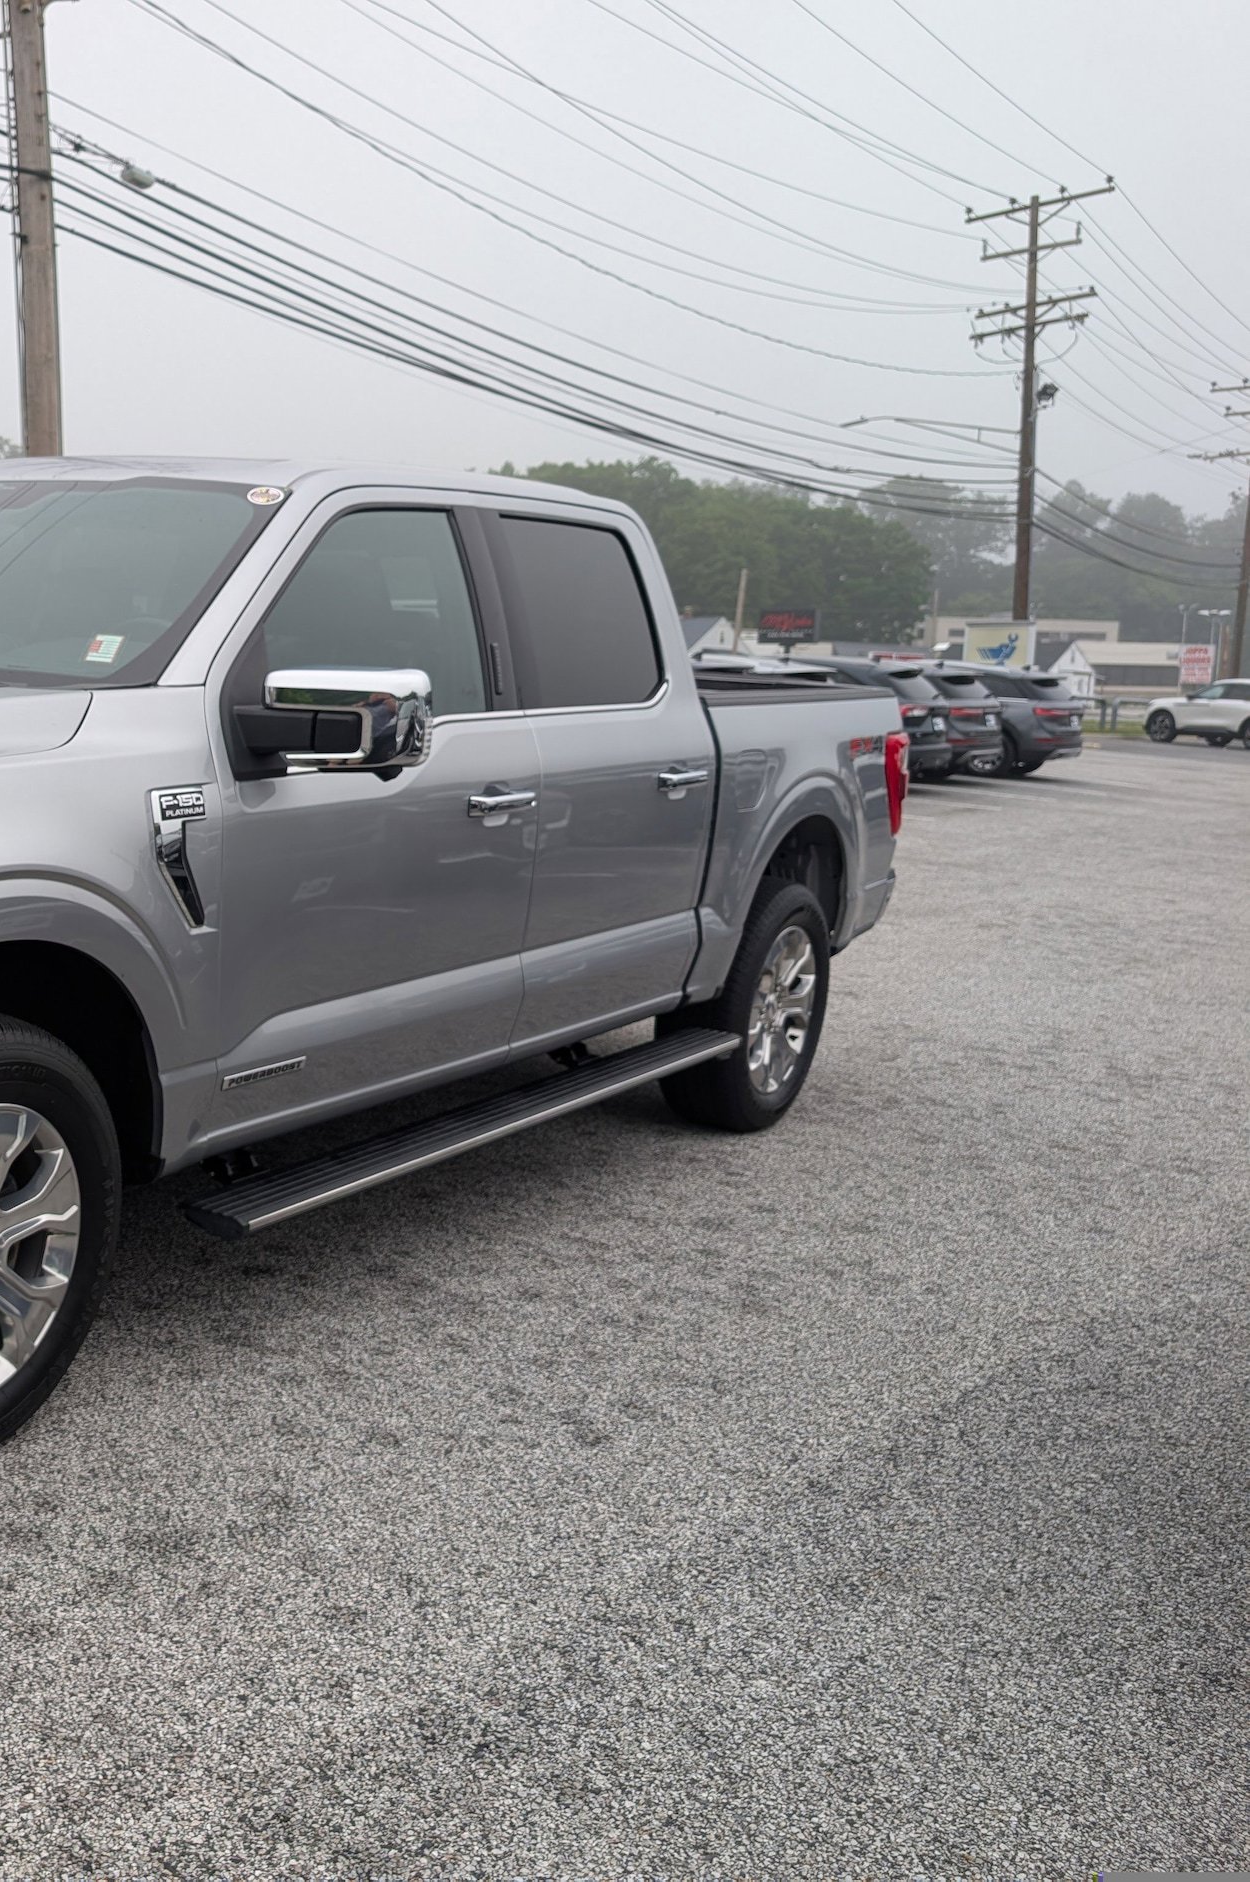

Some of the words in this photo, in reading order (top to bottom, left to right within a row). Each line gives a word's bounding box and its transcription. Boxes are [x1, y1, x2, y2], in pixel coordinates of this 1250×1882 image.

[849, 736, 883, 753] FX4
[160, 793, 204, 809] F-150
[165, 806, 204, 818] PLATINUM
[228, 1061, 303, 1087] POWERBOOST
